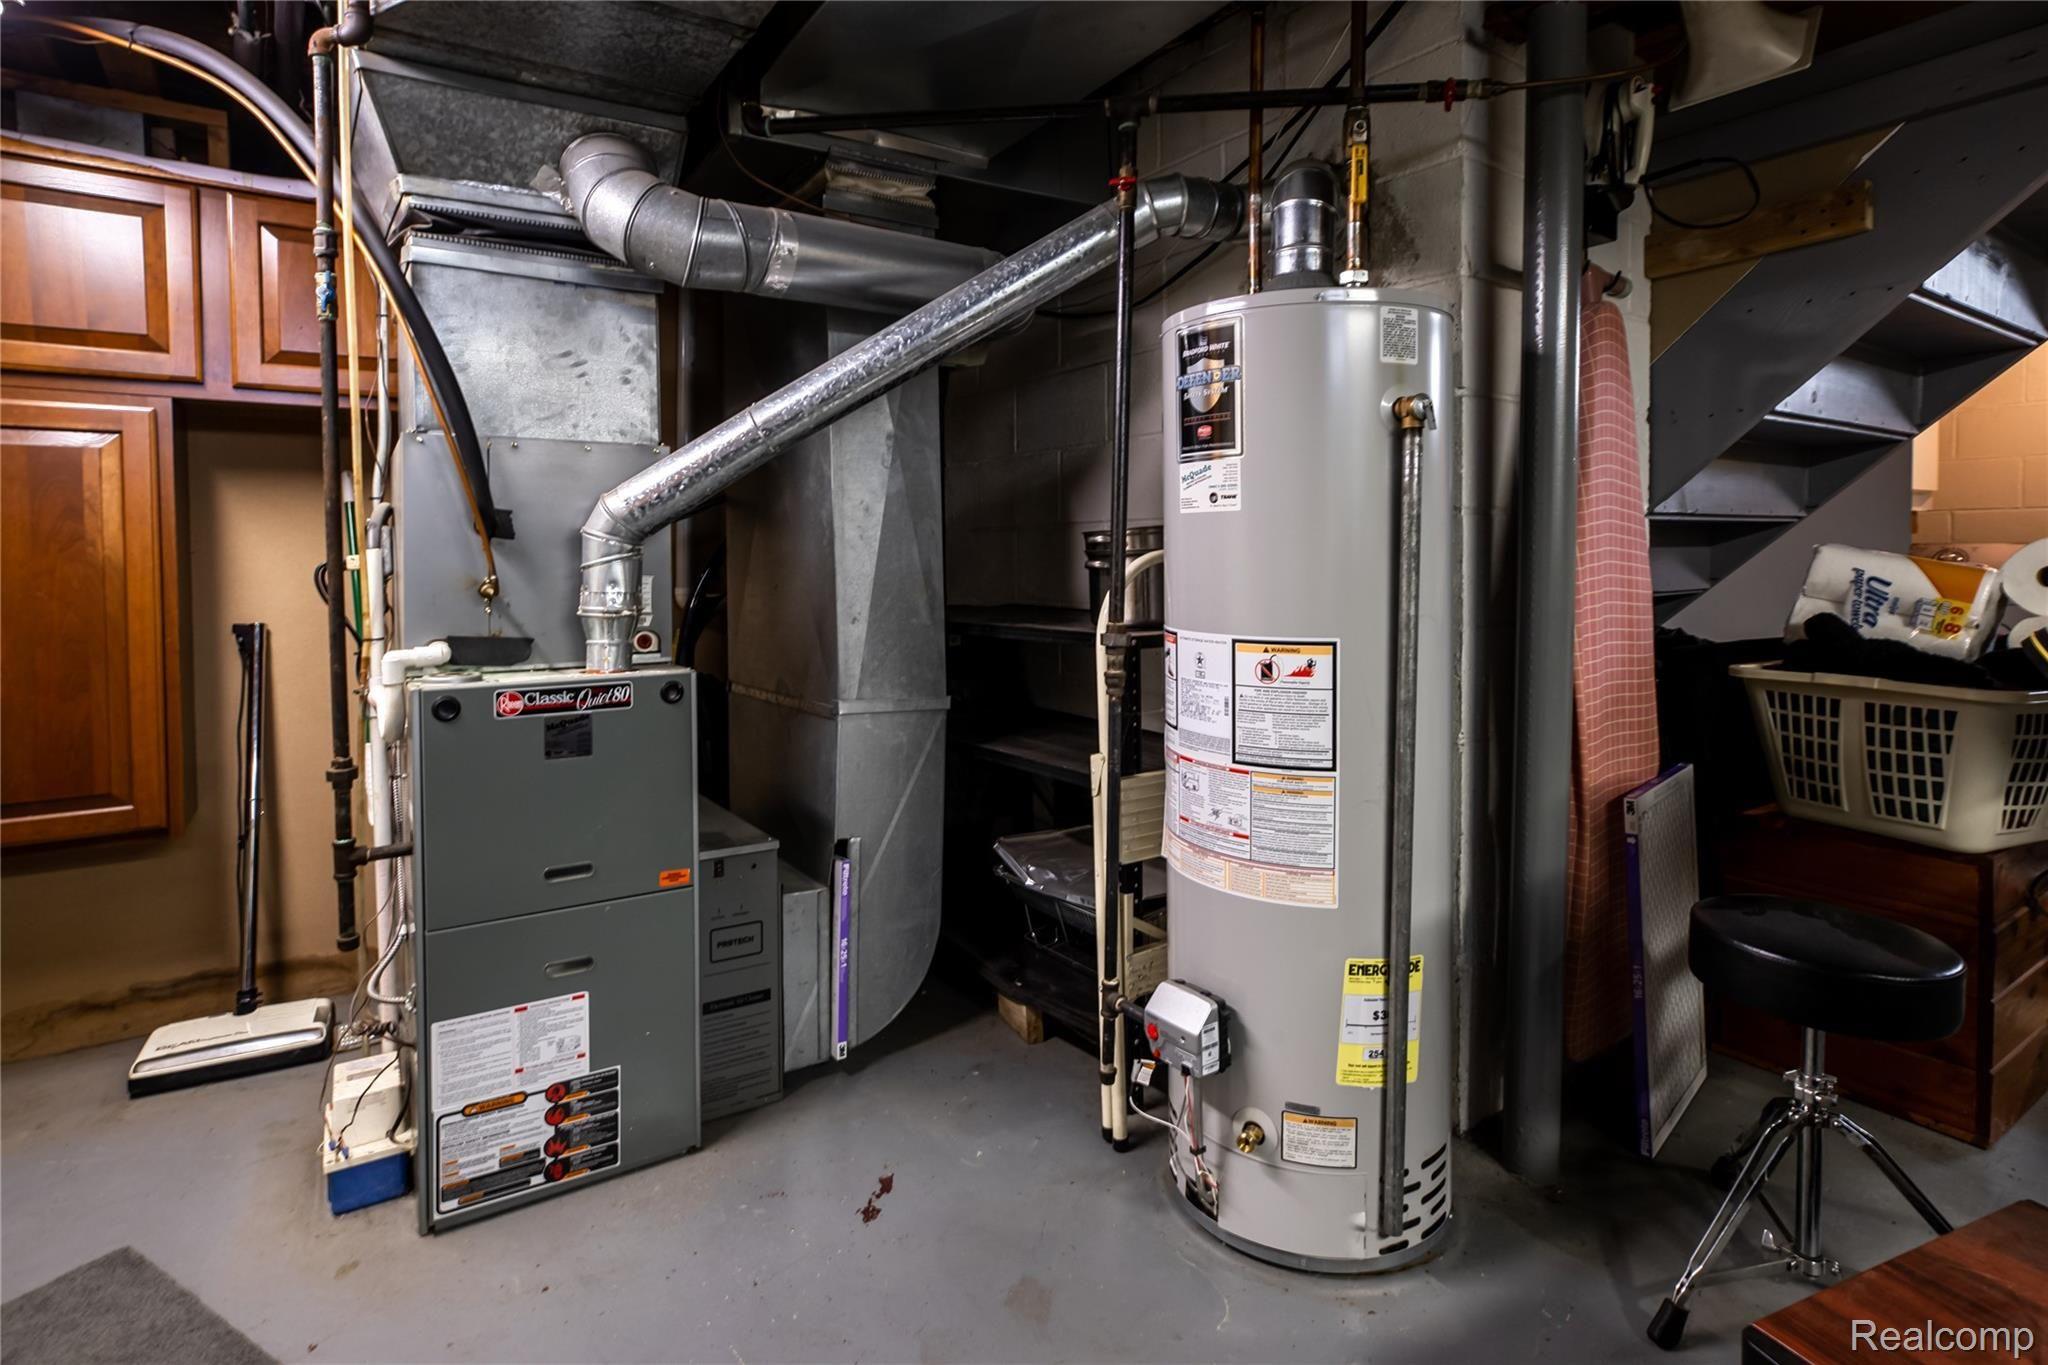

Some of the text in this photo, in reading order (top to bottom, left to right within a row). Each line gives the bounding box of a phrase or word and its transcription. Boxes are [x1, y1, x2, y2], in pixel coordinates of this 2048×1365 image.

[1177, 365, 1241, 391] DEFENDER
[1863, 575, 1892, 628] Ultra
[1943, 622, 1962, 634] 8
[525, 690, 575, 706] Classic
[1308, 1118, 1337, 1127] WARNING
